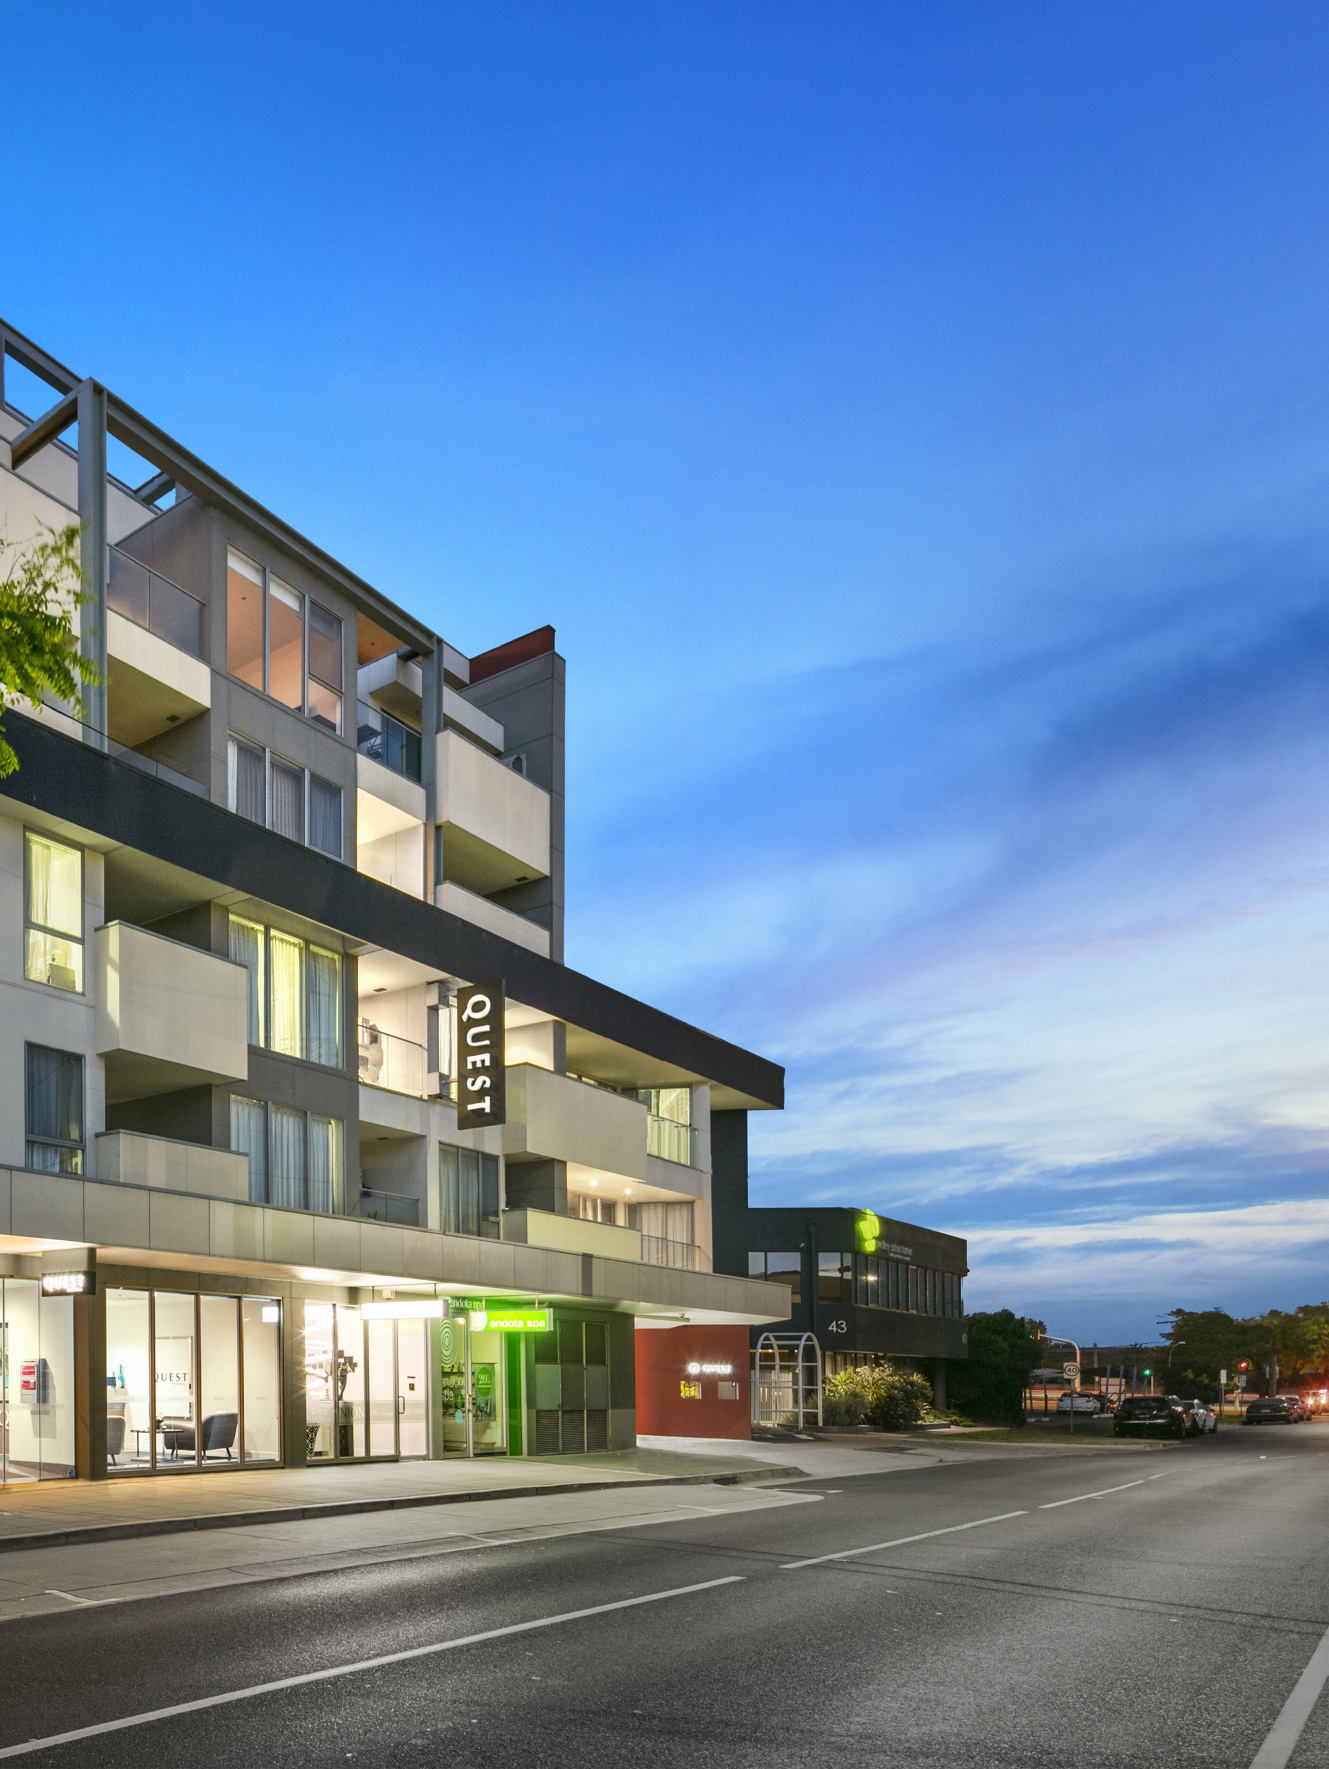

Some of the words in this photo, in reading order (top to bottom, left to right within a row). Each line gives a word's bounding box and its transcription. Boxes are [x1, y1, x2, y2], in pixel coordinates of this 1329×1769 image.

[462, 994, 490, 1113] QUEST
[43, 1275, 85, 1292] QUEST
[490, 1319, 524, 1328] endota
[527, 1320, 546, 1328] spa
[828, 1320, 847, 1333] 43
[154, 1373, 188, 1383] QUEST
